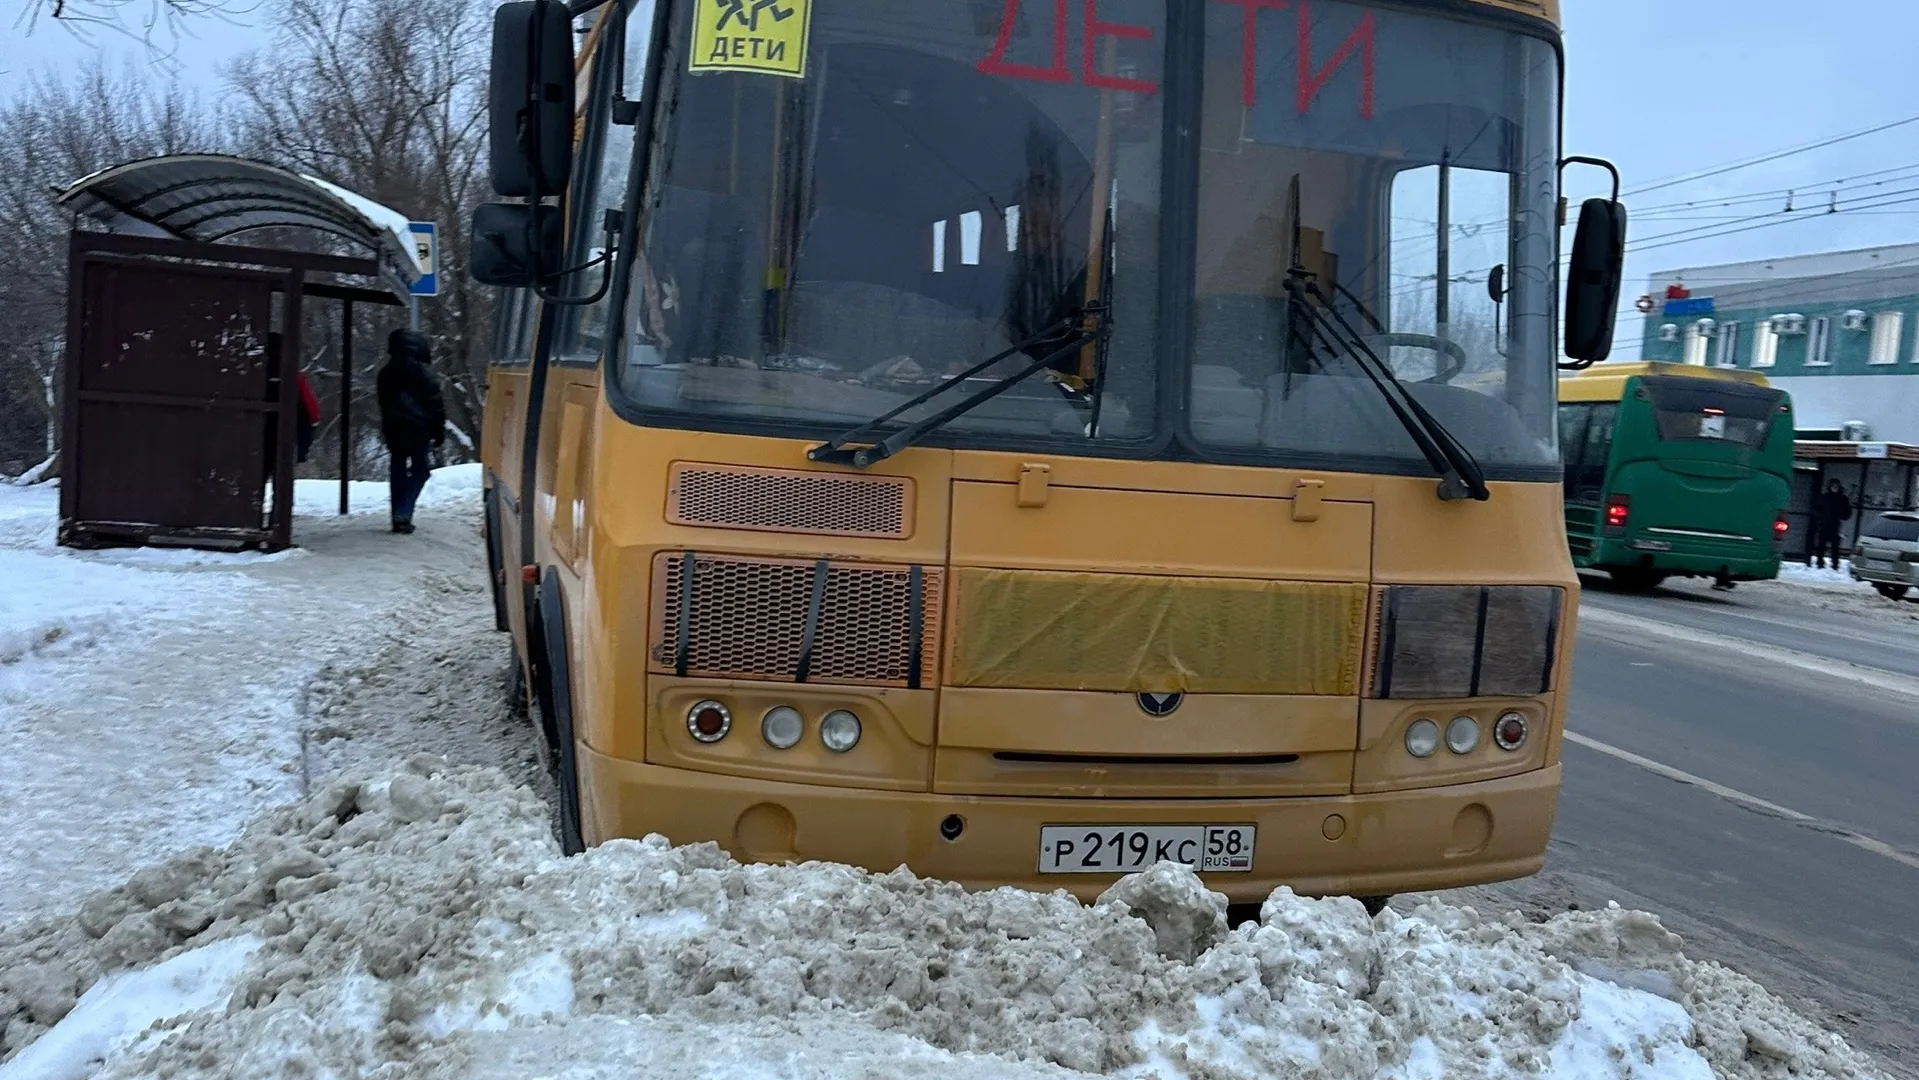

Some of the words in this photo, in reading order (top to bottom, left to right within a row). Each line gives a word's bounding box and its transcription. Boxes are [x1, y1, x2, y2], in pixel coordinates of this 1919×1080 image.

[709, 36, 786, 62] ДЕТИ
[1208, 829, 1242, 855] 58
[1204, 857, 1229, 867] RUS
